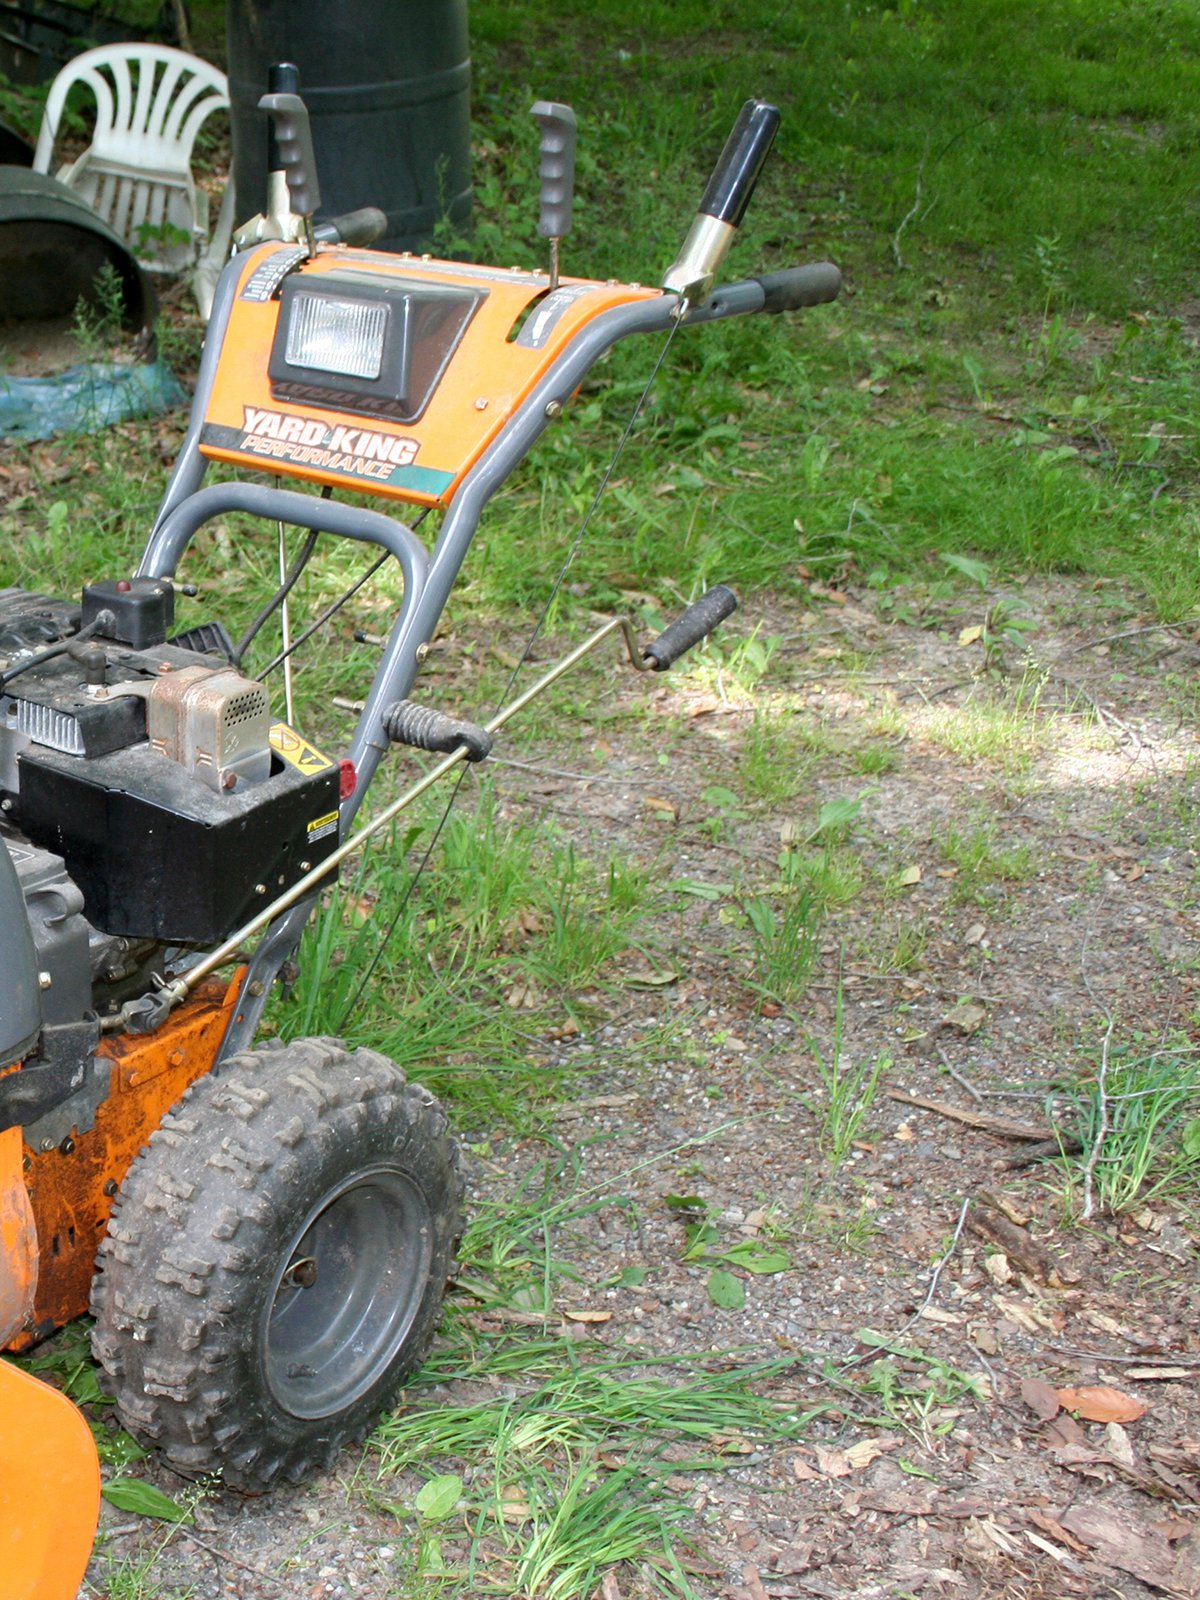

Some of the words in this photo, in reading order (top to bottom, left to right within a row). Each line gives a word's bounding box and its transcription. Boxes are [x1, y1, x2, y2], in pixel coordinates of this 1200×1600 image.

[240, 434, 397, 480] PERFORMANCE
[243, 406, 329, 446] YARD
[322, 425, 419, 466] KING
